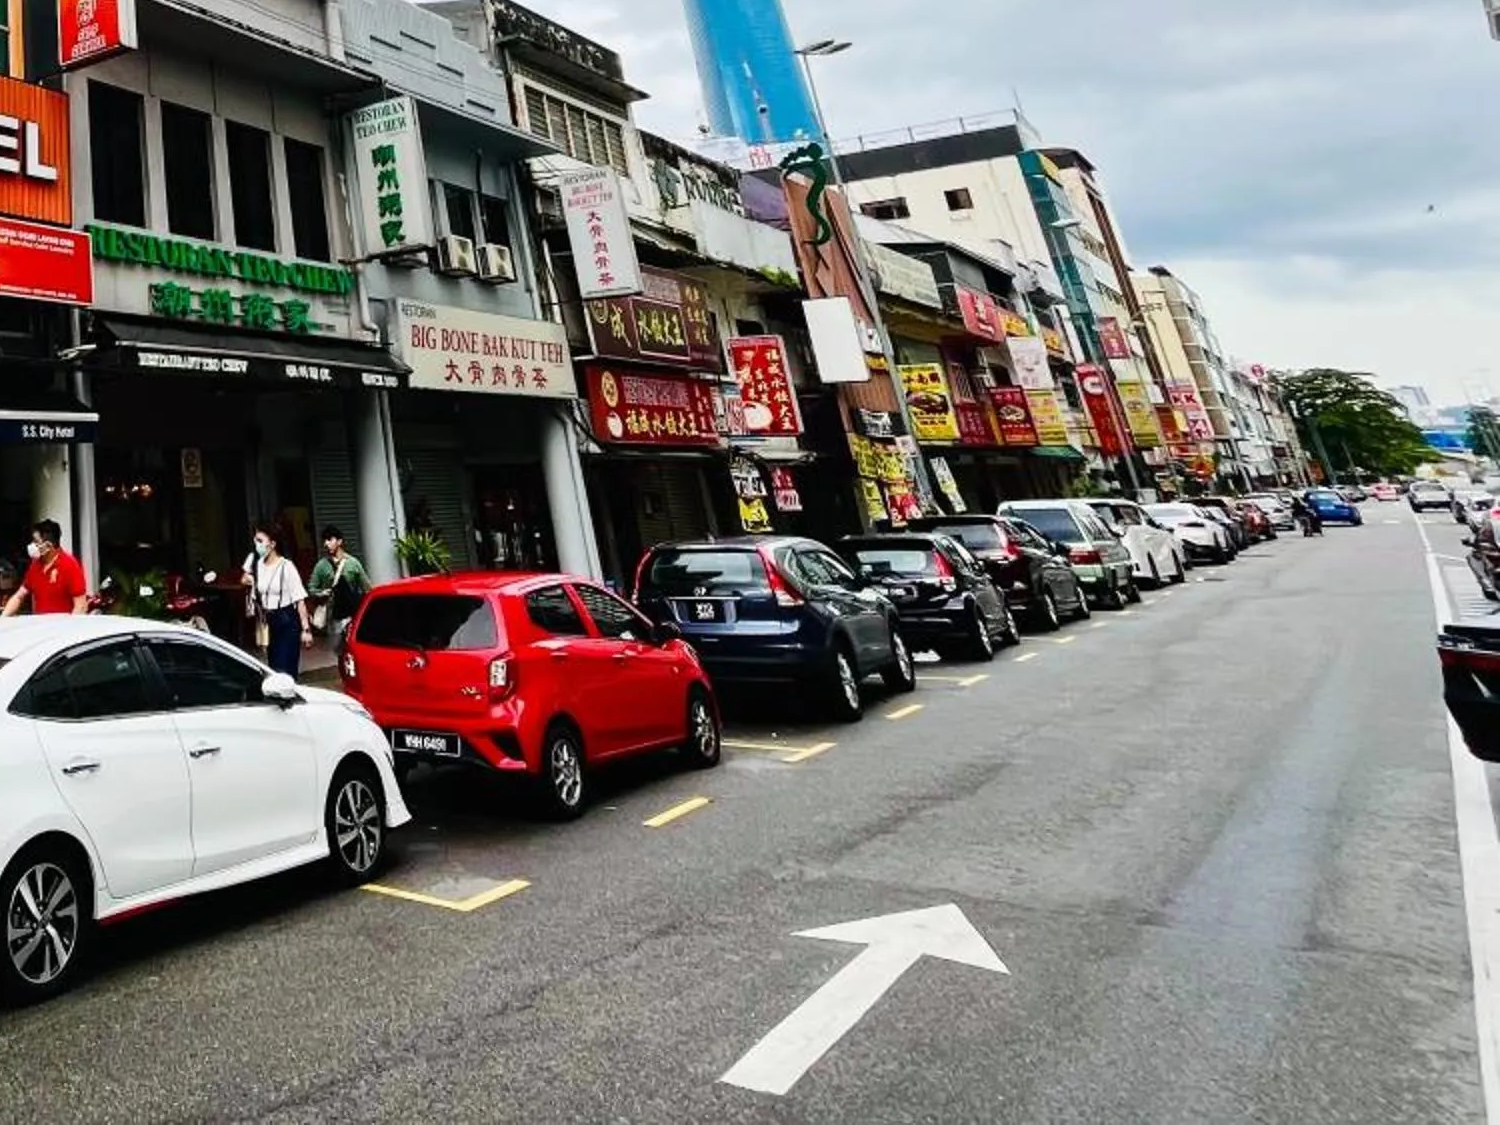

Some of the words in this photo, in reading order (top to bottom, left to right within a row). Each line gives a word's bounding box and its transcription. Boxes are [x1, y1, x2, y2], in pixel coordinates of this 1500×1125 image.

[411, 325, 437, 350] BIG
[441, 328, 479, 355] BONE
[482, 334, 509, 359] BAK
[511, 336, 537, 360] KUT
[540, 340, 564, 364] TEH
[444, 359, 548, 390] 大骨肉骨茶
